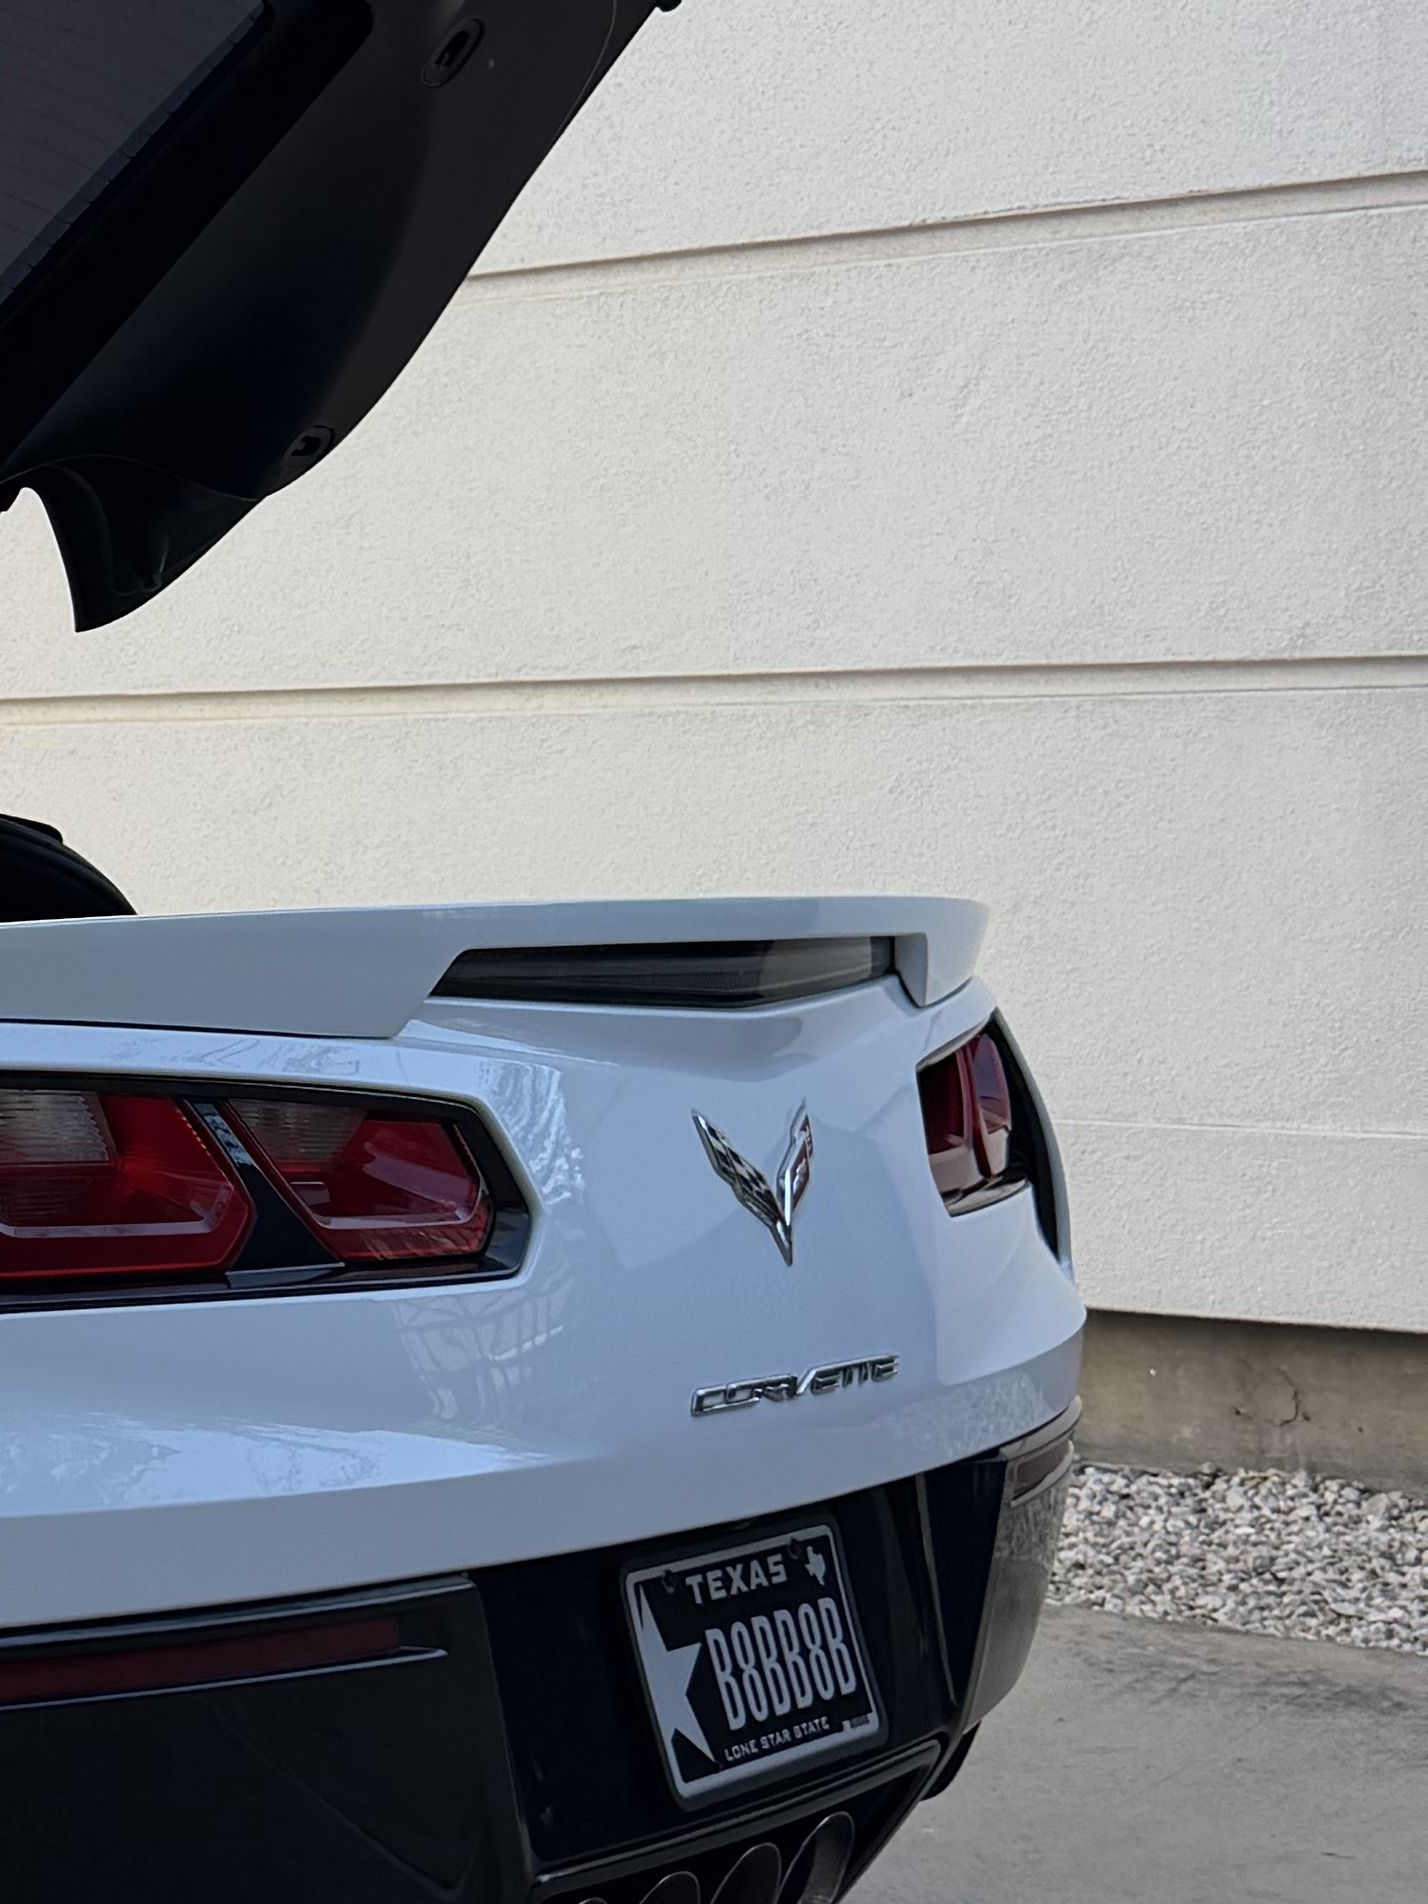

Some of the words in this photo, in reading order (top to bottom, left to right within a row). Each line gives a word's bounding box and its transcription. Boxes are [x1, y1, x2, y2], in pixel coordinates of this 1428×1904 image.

[691, 1354, 899, 1417] CORVETTE
[685, 1553, 788, 1604] TEXAS
[705, 1597, 857, 1731] B8BB8B
[724, 1739, 758, 1762] LONE
[762, 1728, 793, 1751] STAR
[792, 1716, 830, 1740] STATE
